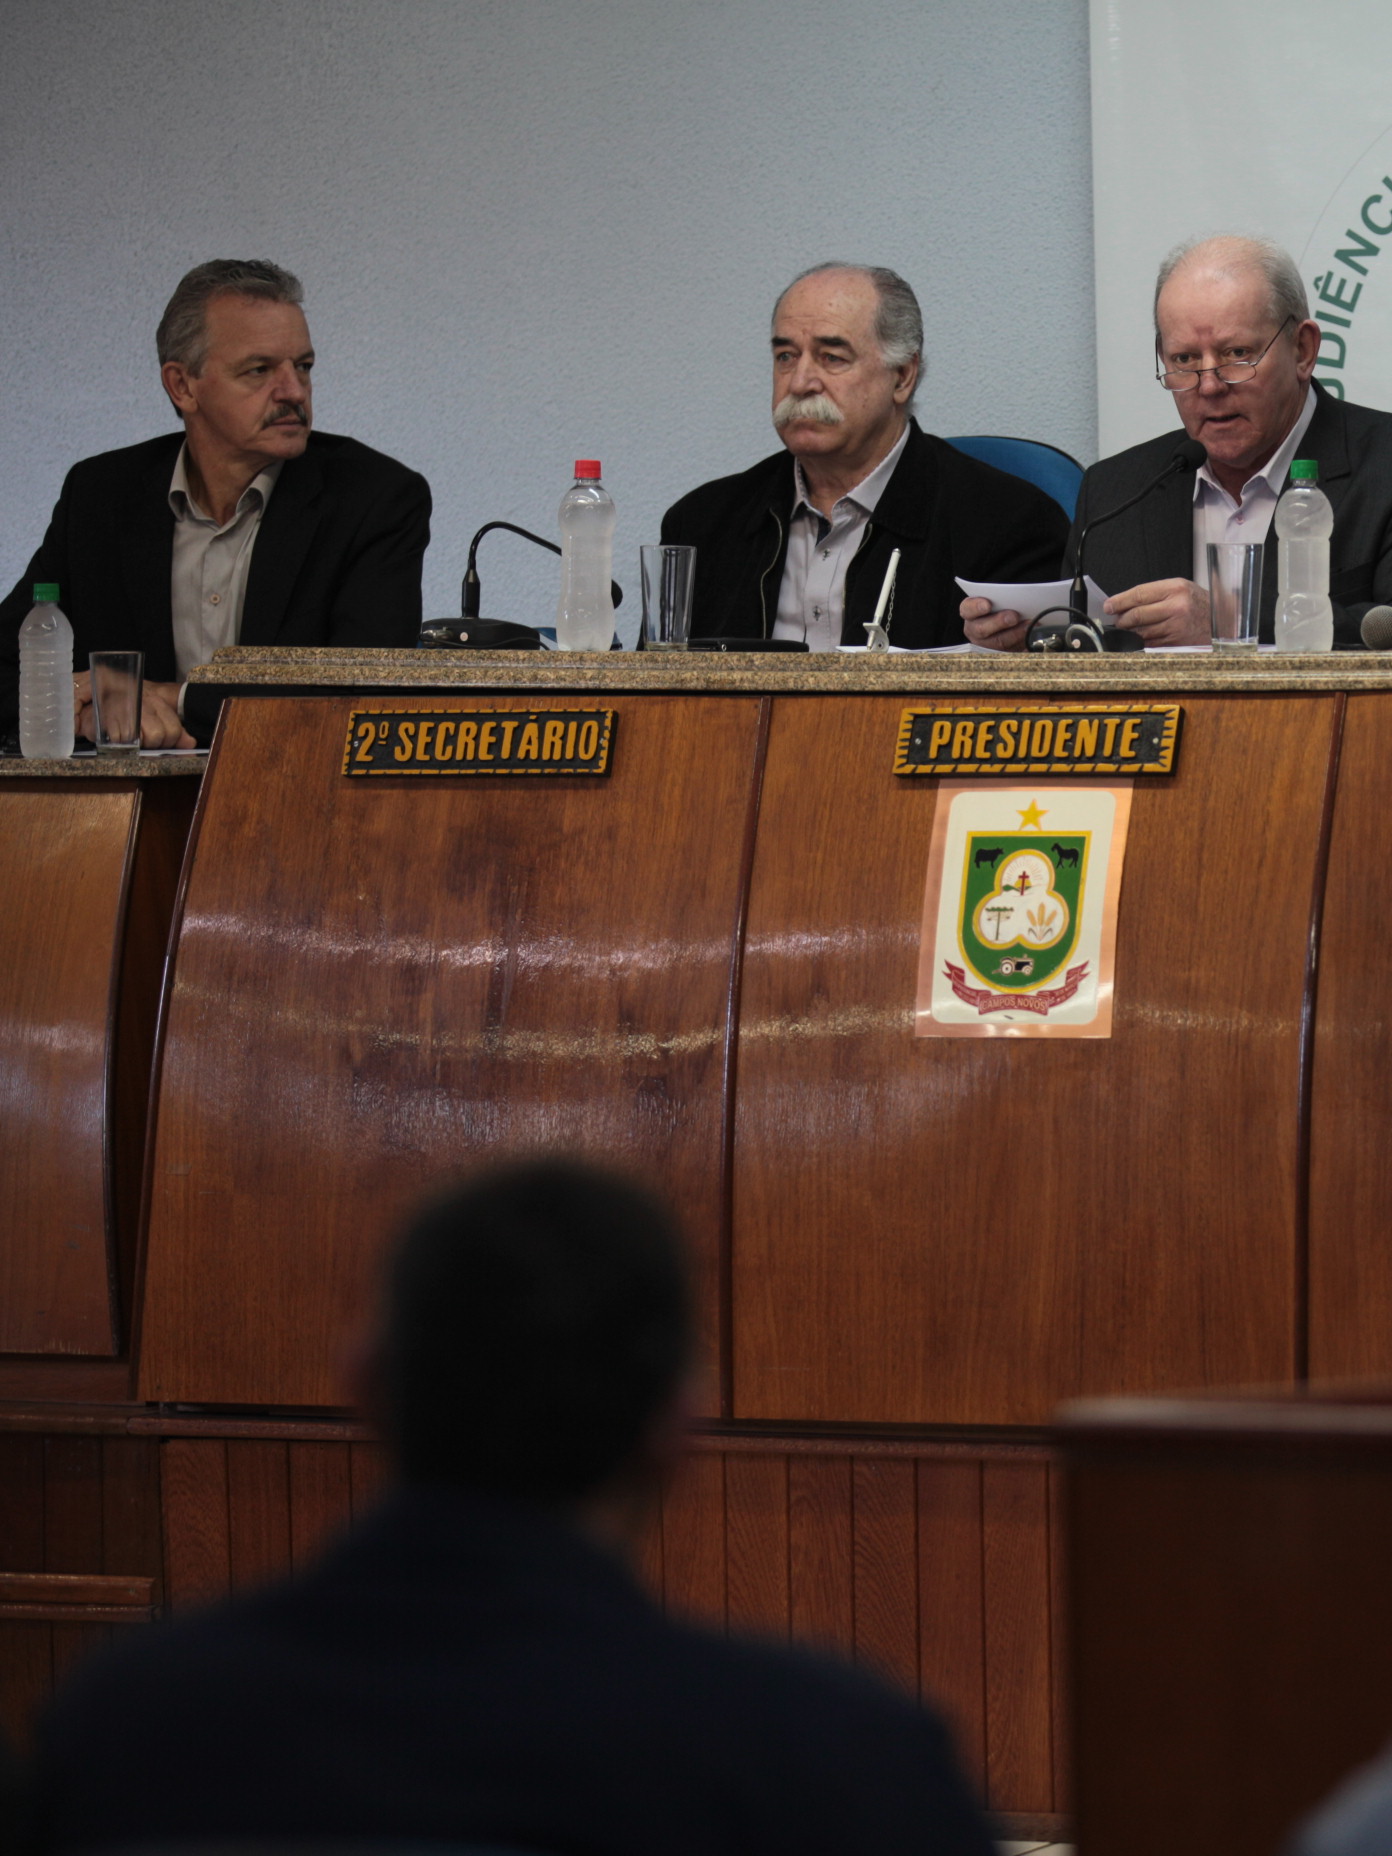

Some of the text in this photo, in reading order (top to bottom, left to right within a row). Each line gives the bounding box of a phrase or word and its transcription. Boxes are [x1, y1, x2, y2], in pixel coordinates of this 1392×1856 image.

[394, 715, 599, 762] SECRETÁRIO
[928, 718, 1142, 760] PRESIDENTE
[981, 996, 1046, 1012] CAMPOS NOVOS
